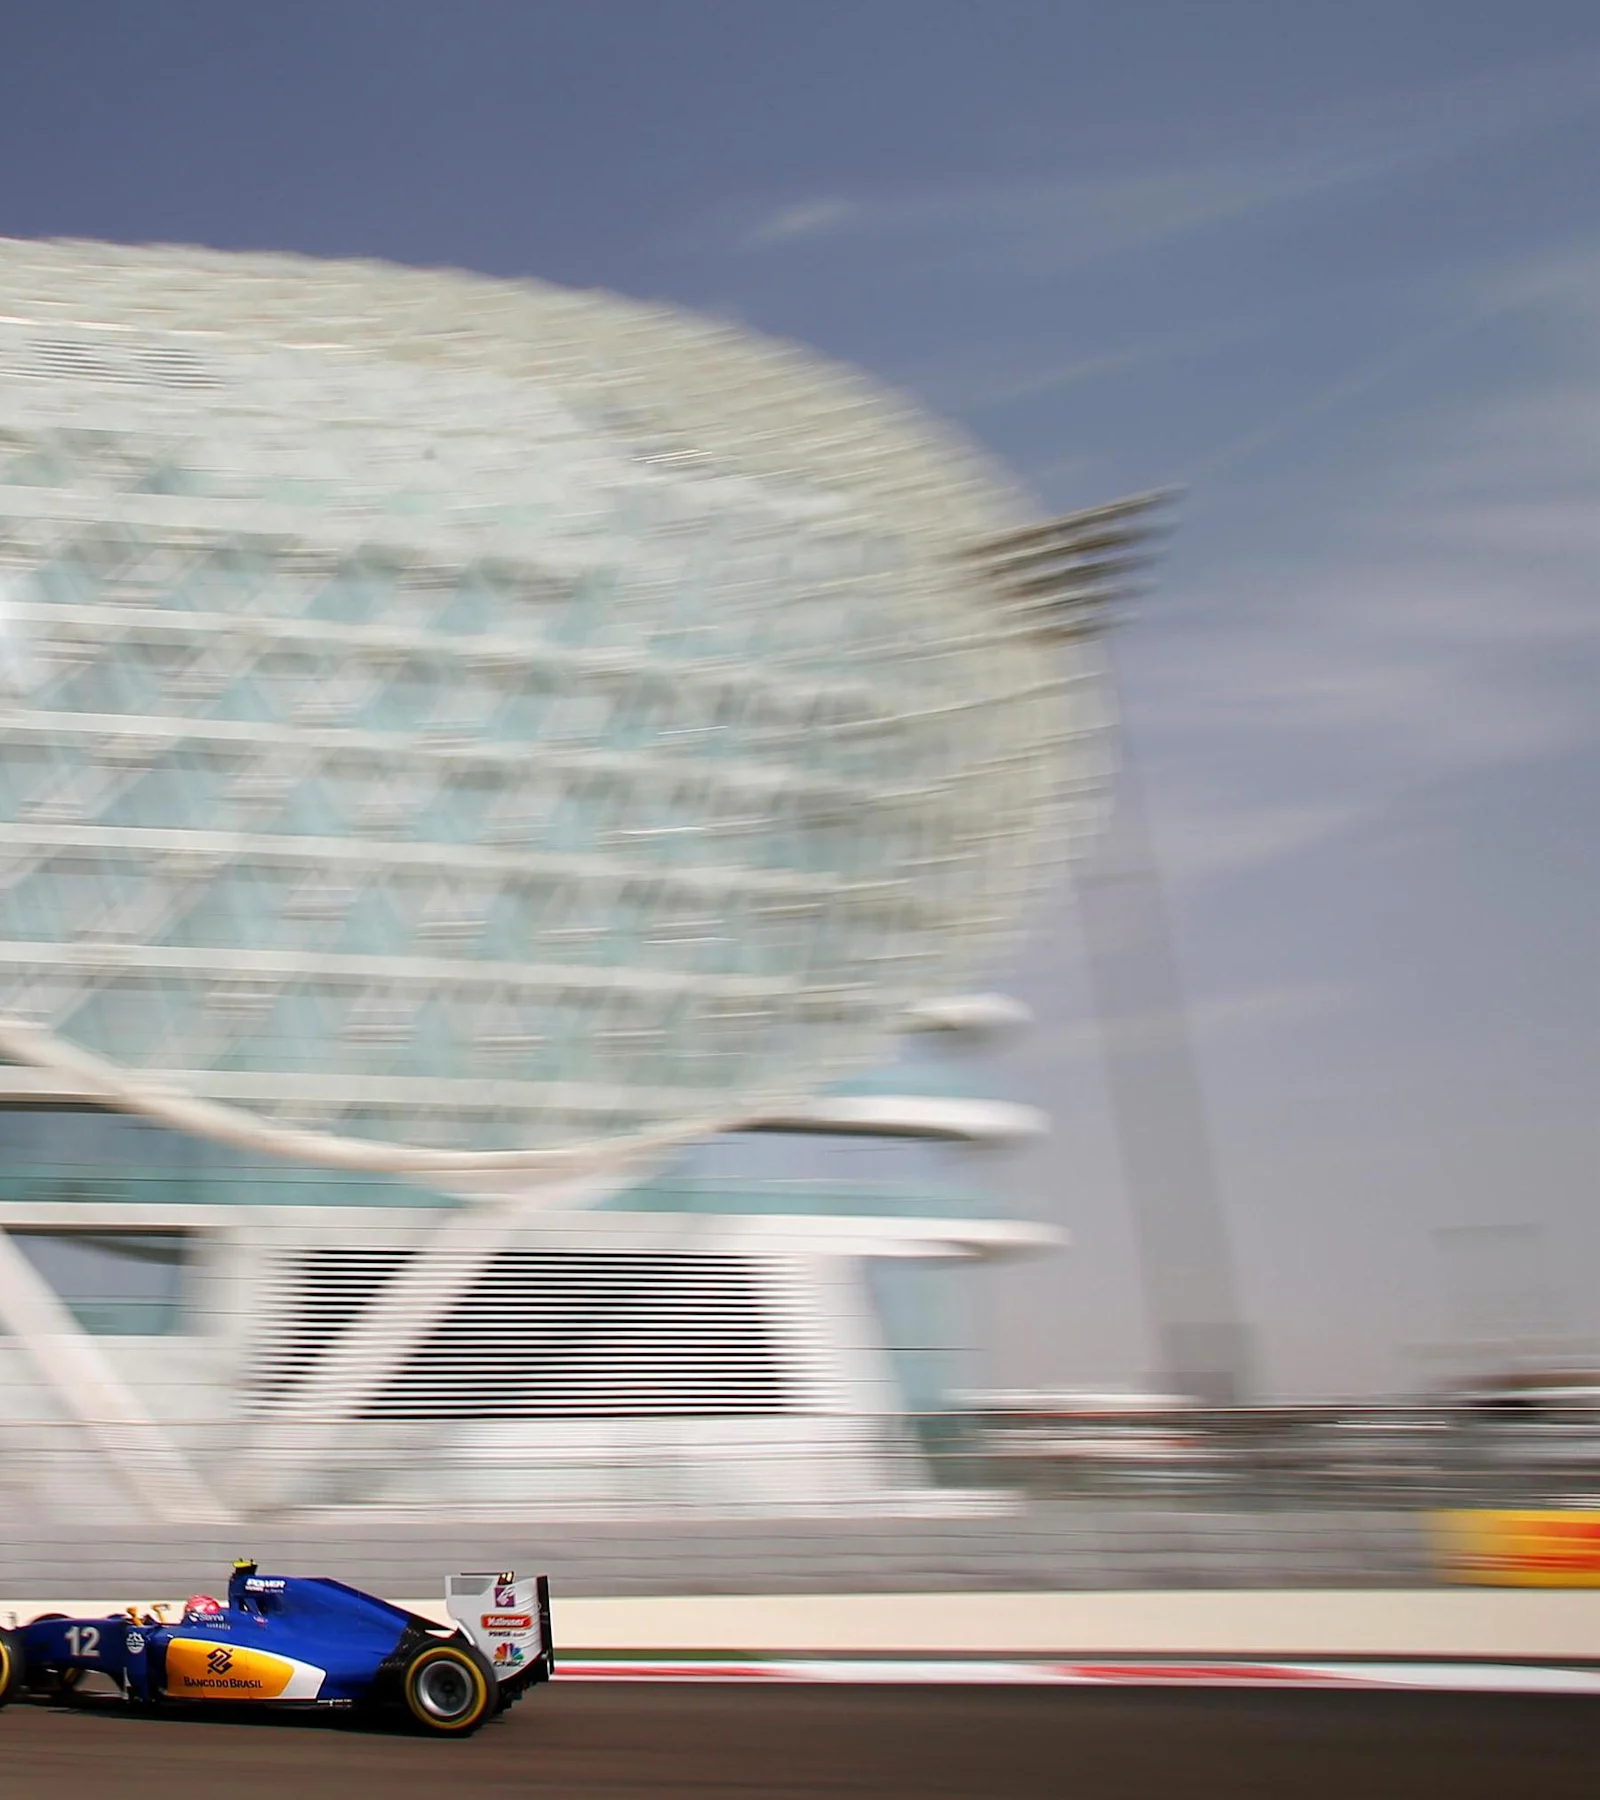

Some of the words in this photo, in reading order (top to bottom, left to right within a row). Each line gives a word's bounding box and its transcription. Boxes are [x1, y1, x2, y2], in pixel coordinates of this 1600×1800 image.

[64, 1625, 101, 1656] 12
[183, 1676, 215, 1688] BANCO
[216, 1679, 229, 1688] DO
[229, 1678, 263, 1689] BRASIL
